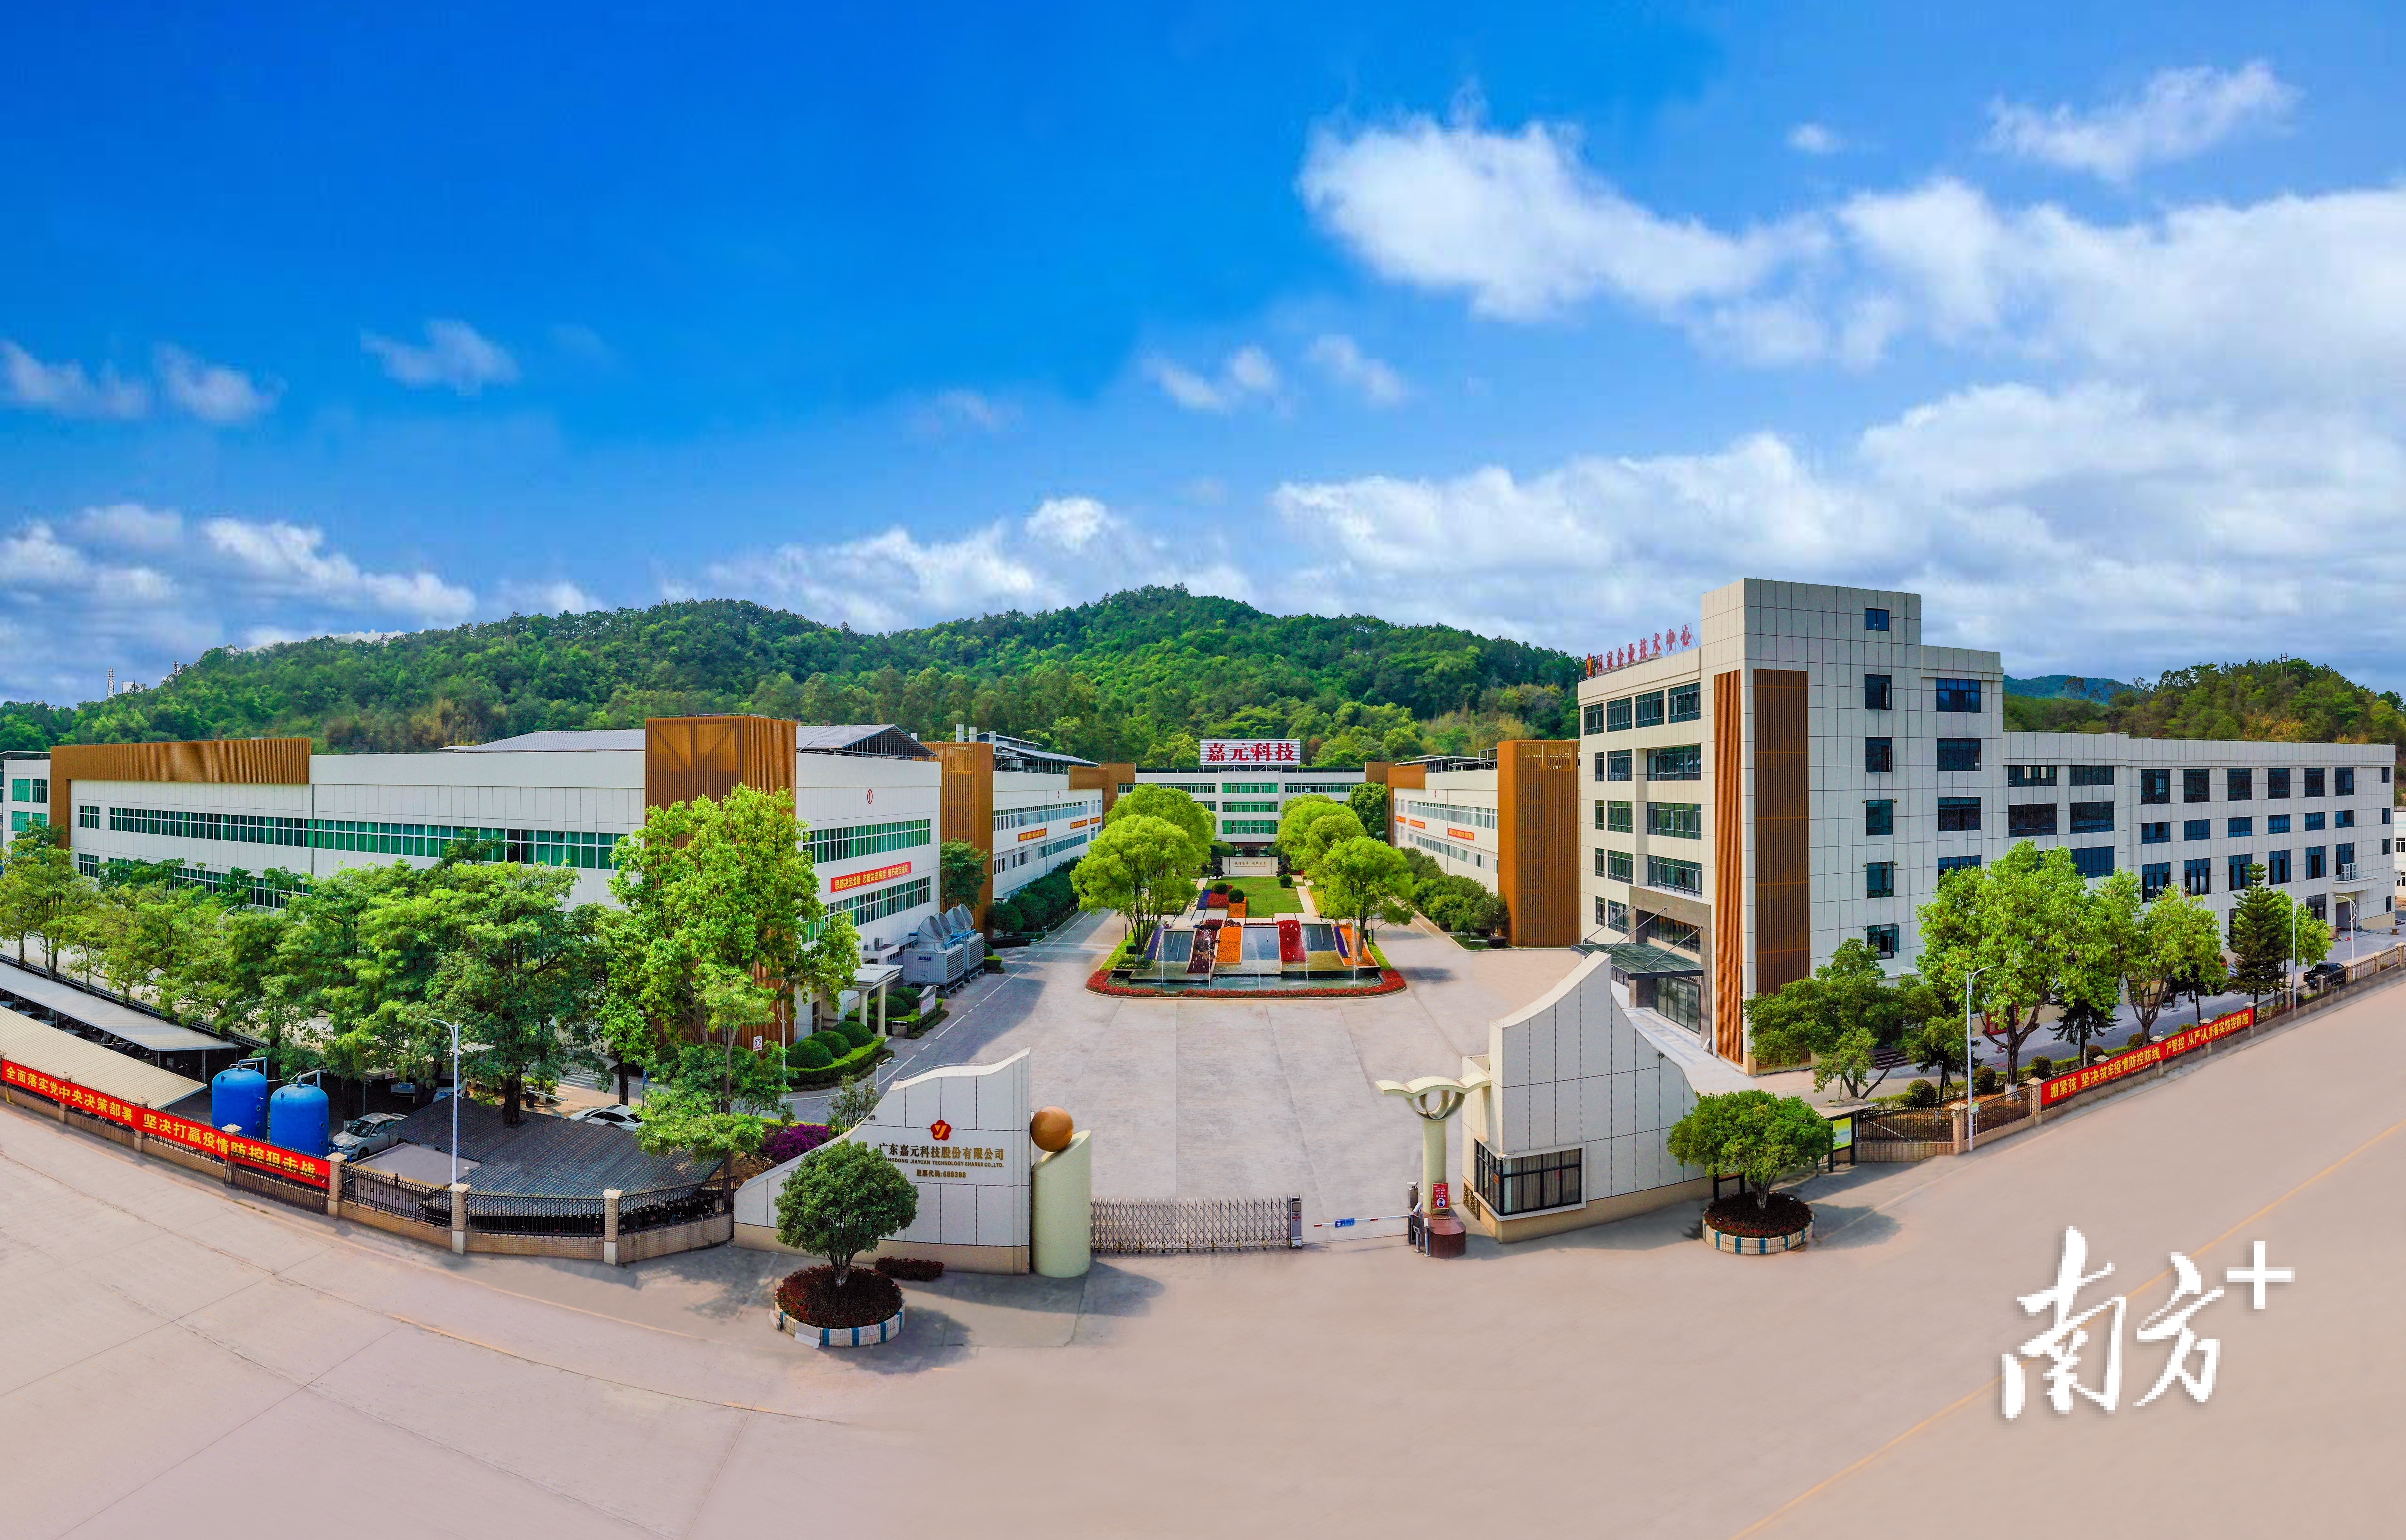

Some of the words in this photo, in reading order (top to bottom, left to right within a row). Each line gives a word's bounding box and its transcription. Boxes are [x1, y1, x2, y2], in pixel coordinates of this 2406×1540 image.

[1597, 624, 1691, 673] 国家企业技术中心
[1207, 743, 1295, 762] 嘉元科技
[835, 875, 861, 890] 思路决定出路
[863, 870, 886, 883] 态度决定高度
[888, 865, 908, 877] 细节决定成败
[2081, 1047, 2161, 1087] 坚决筑牢疫情防控防线
[2166, 1036, 2185, 1055] 严管控
[2188, 1013, 2249, 1046] 从严从紧落实防控措施
[6, 1066, 133, 1122] 全面落实党中央决策部署
[143, 1114, 316, 1179] 坚决打赢疫情防控狙击战
[879, 1142, 1004, 1161] 广东嘉元科技股份有限公司
